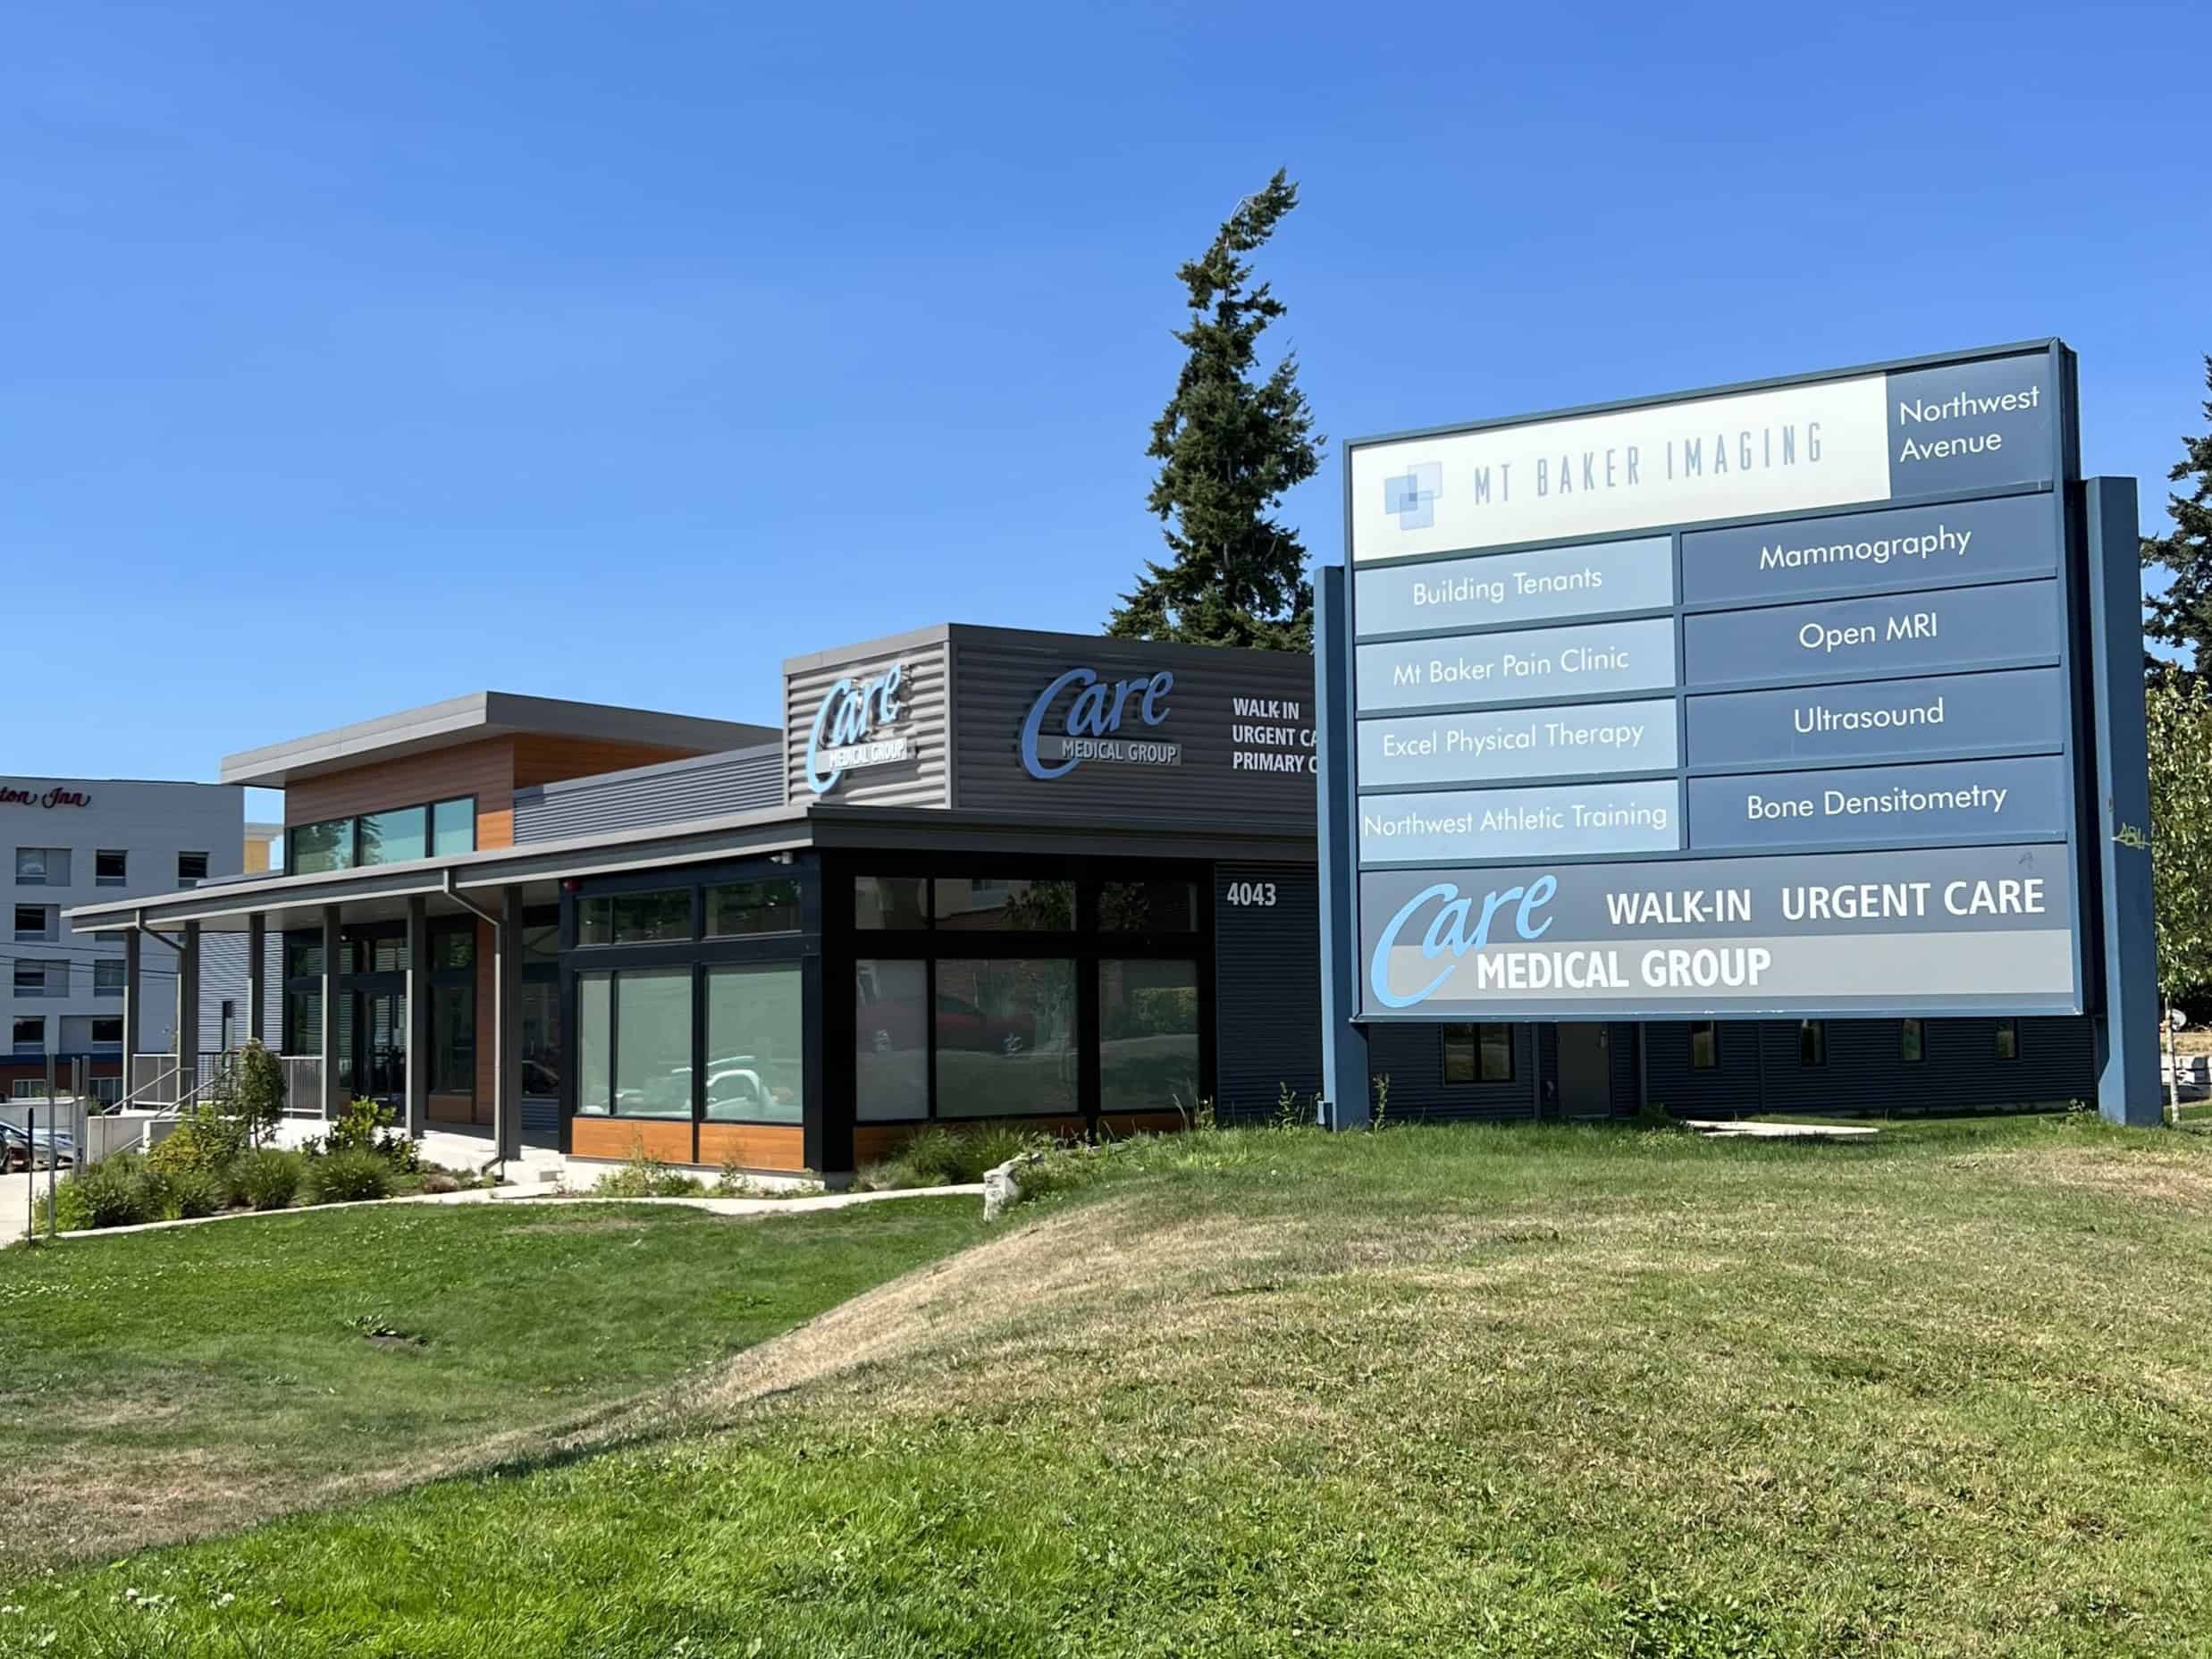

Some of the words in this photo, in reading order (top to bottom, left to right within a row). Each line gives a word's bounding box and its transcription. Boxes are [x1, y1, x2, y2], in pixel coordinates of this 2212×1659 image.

[1899, 385, 2040, 425] Northwest
[1475, 462, 1511, 505] MT
[1536, 446, 1639, 497] BAKER
[1667, 421, 1821, 480] IMAGING
[1899, 433, 2002, 463] Avenue
[1759, 525, 1972, 570] Mammography
[1413, 577, 1504, 605] Building
[1513, 568, 1602, 595] Tenants
[1799, 623, 1876, 653] Open
[1886, 611, 1938, 641] MRI
[1393, 663, 1422, 686] Mt
[1430, 657, 1494, 684] Baker
[1503, 653, 1551, 678] Pain
[1560, 644, 1629, 673] Clinic
[807, 662, 902, 794] Care
[1022, 668, 1173, 779] Care
[1794, 696, 1945, 733] Ultrasound
[871, 742, 906, 763] GROUP
[1062, 739, 1123, 761] MEDICAL
[1128, 743, 1177, 764] GROUP
[1232, 724, 1296, 746] URGENT
[1383, 729, 1437, 758] Excel
[1445, 720, 1536, 757] Physical
[1543, 722, 1645, 749] Therapy
[1233, 751, 1305, 773] PRIMARY
[42, 787, 91, 809] Inn
[1747, 795, 1814, 820] Bone
[1824, 785, 2007, 815] Densitometry
[1364, 813, 1473, 838] Northwest
[1480, 807, 1564, 831] Athletic
[1572, 803, 1668, 830] Training
[1227, 882, 1276, 906] 4043
[1606, 888, 1752, 925] WALK-IN
[1782, 883, 1931, 921] URGENT
[1944, 879, 2046, 916] CARE
[1370, 875, 1558, 1008] Care
[1476, 950, 1629, 990] MEDICAL
[1641, 947, 1771, 987] GROUP
